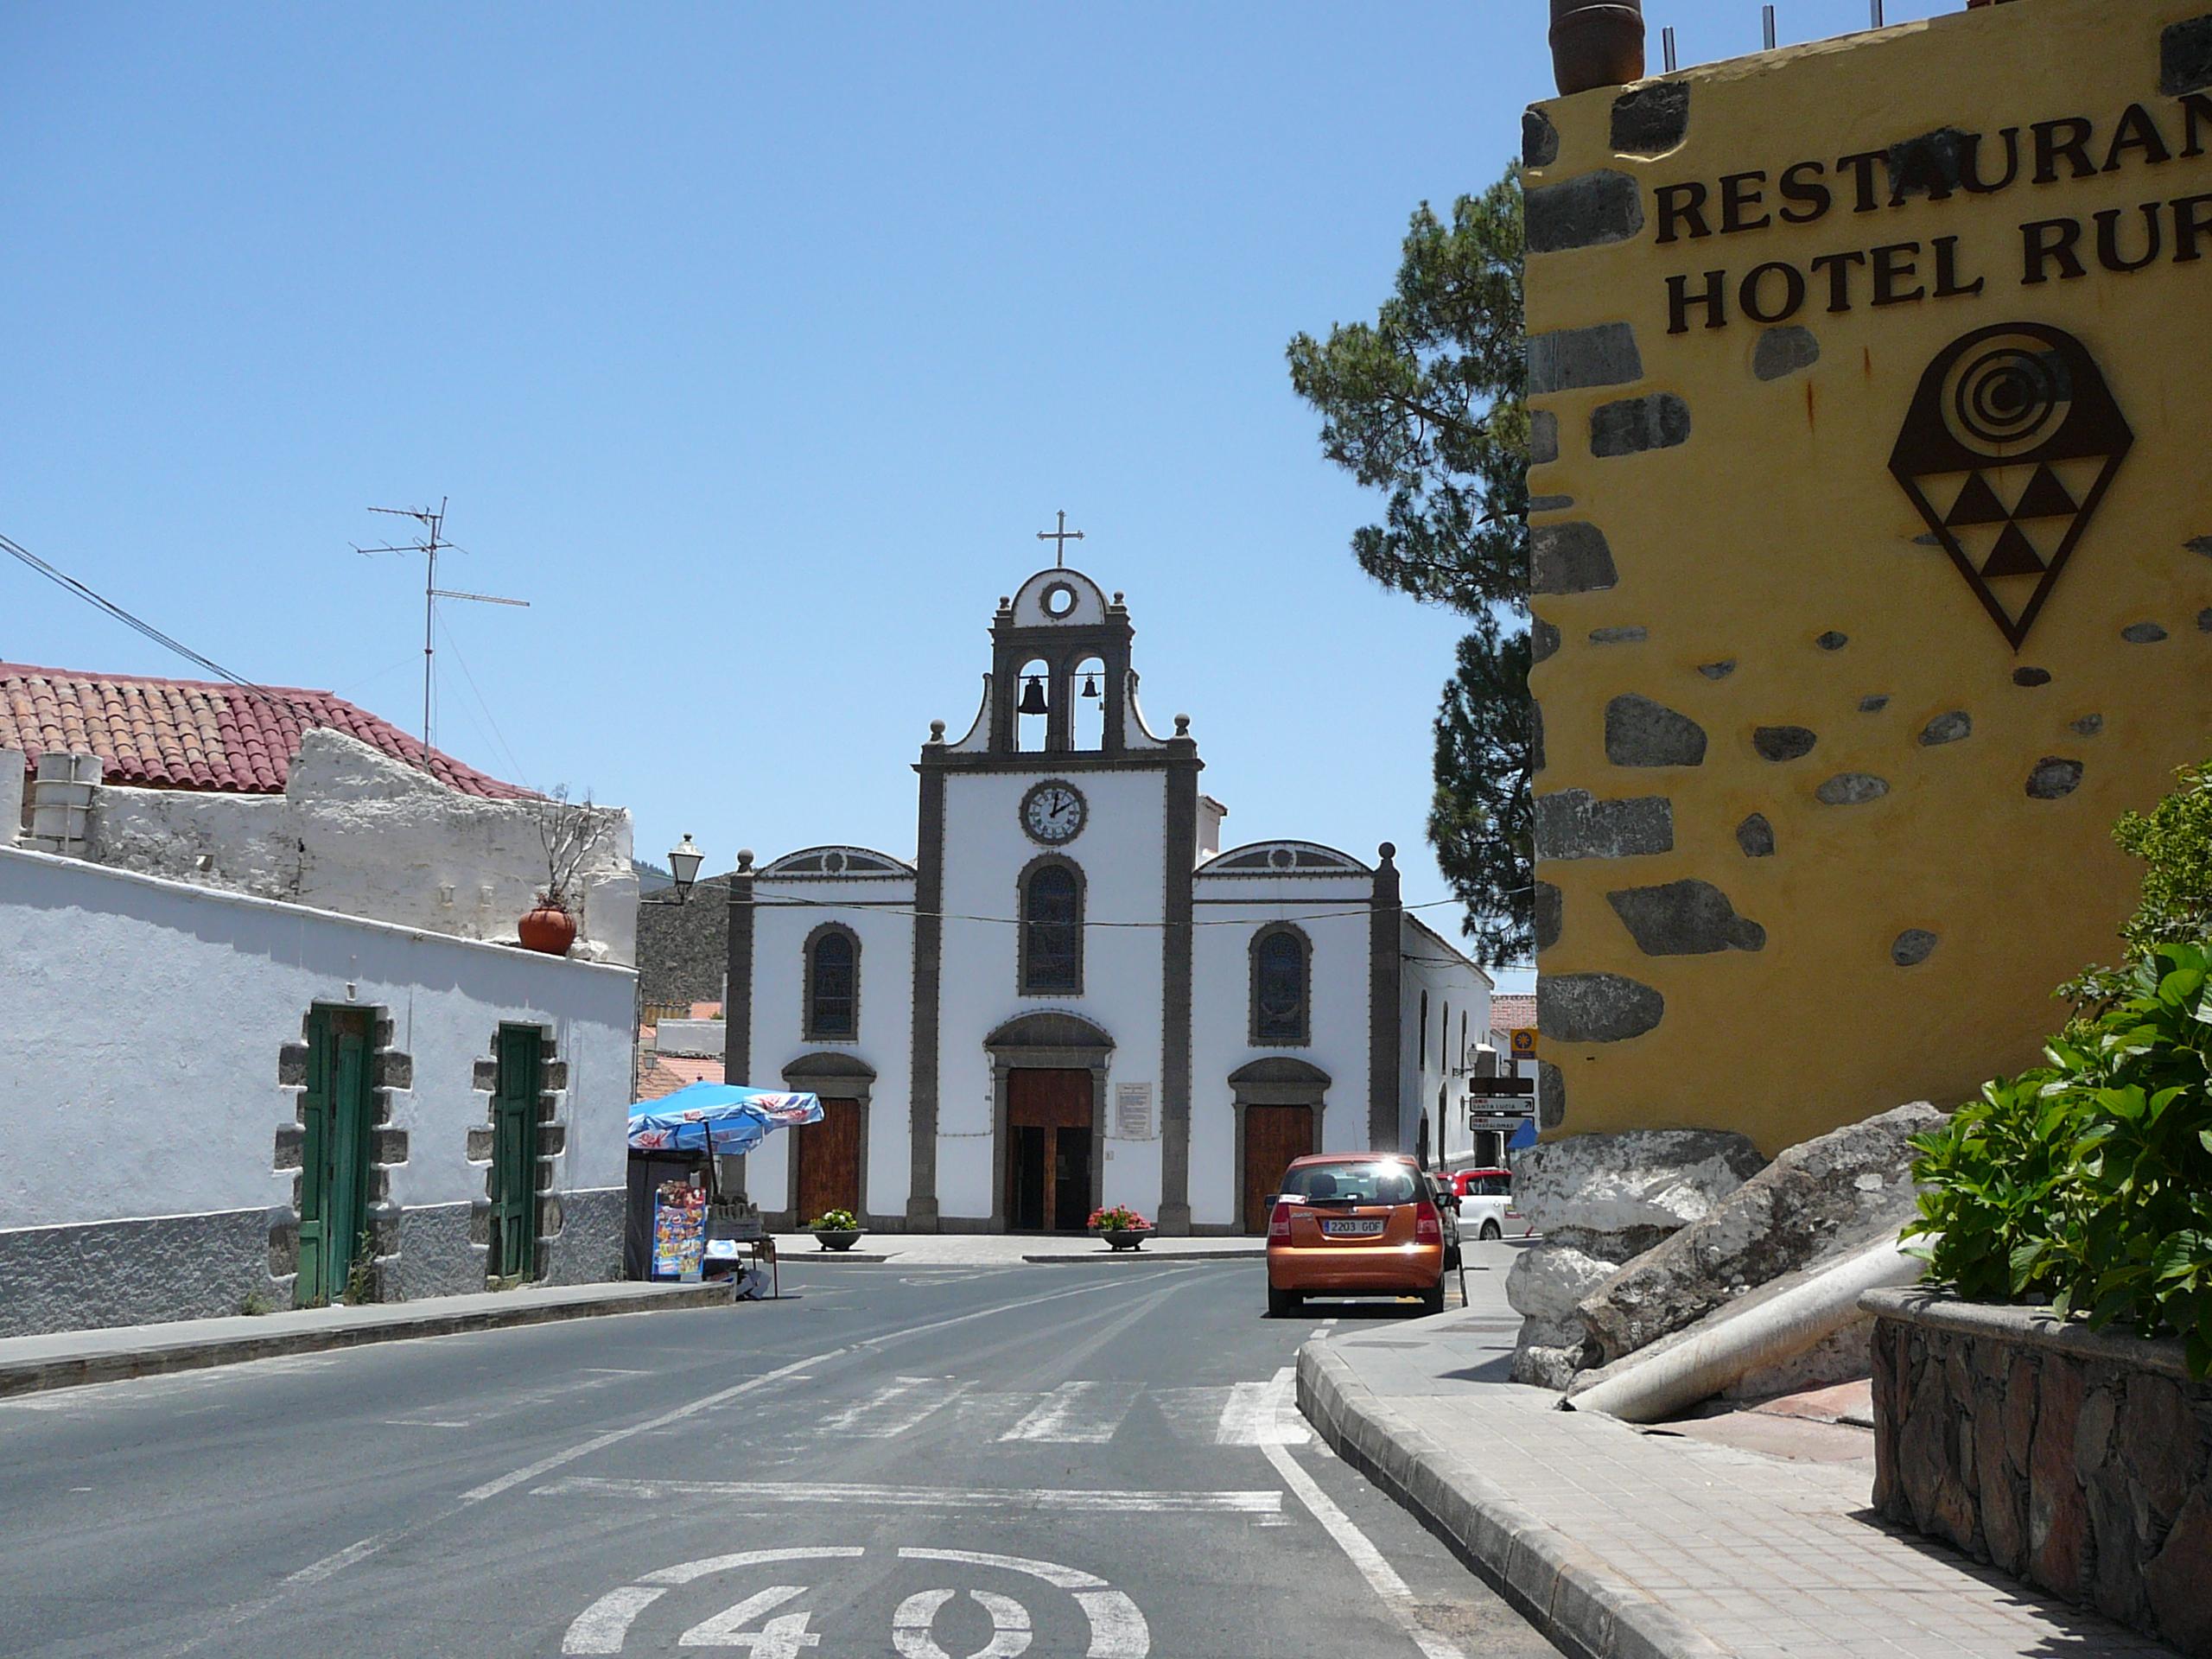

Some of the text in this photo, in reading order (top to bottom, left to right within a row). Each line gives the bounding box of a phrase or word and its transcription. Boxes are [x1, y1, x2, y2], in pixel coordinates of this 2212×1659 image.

[1664, 235, 1985, 334] HOTEL
[1331, 1221, 1381, 1232] 2203 GDF
[678, 1586, 1033, 1659] 40
